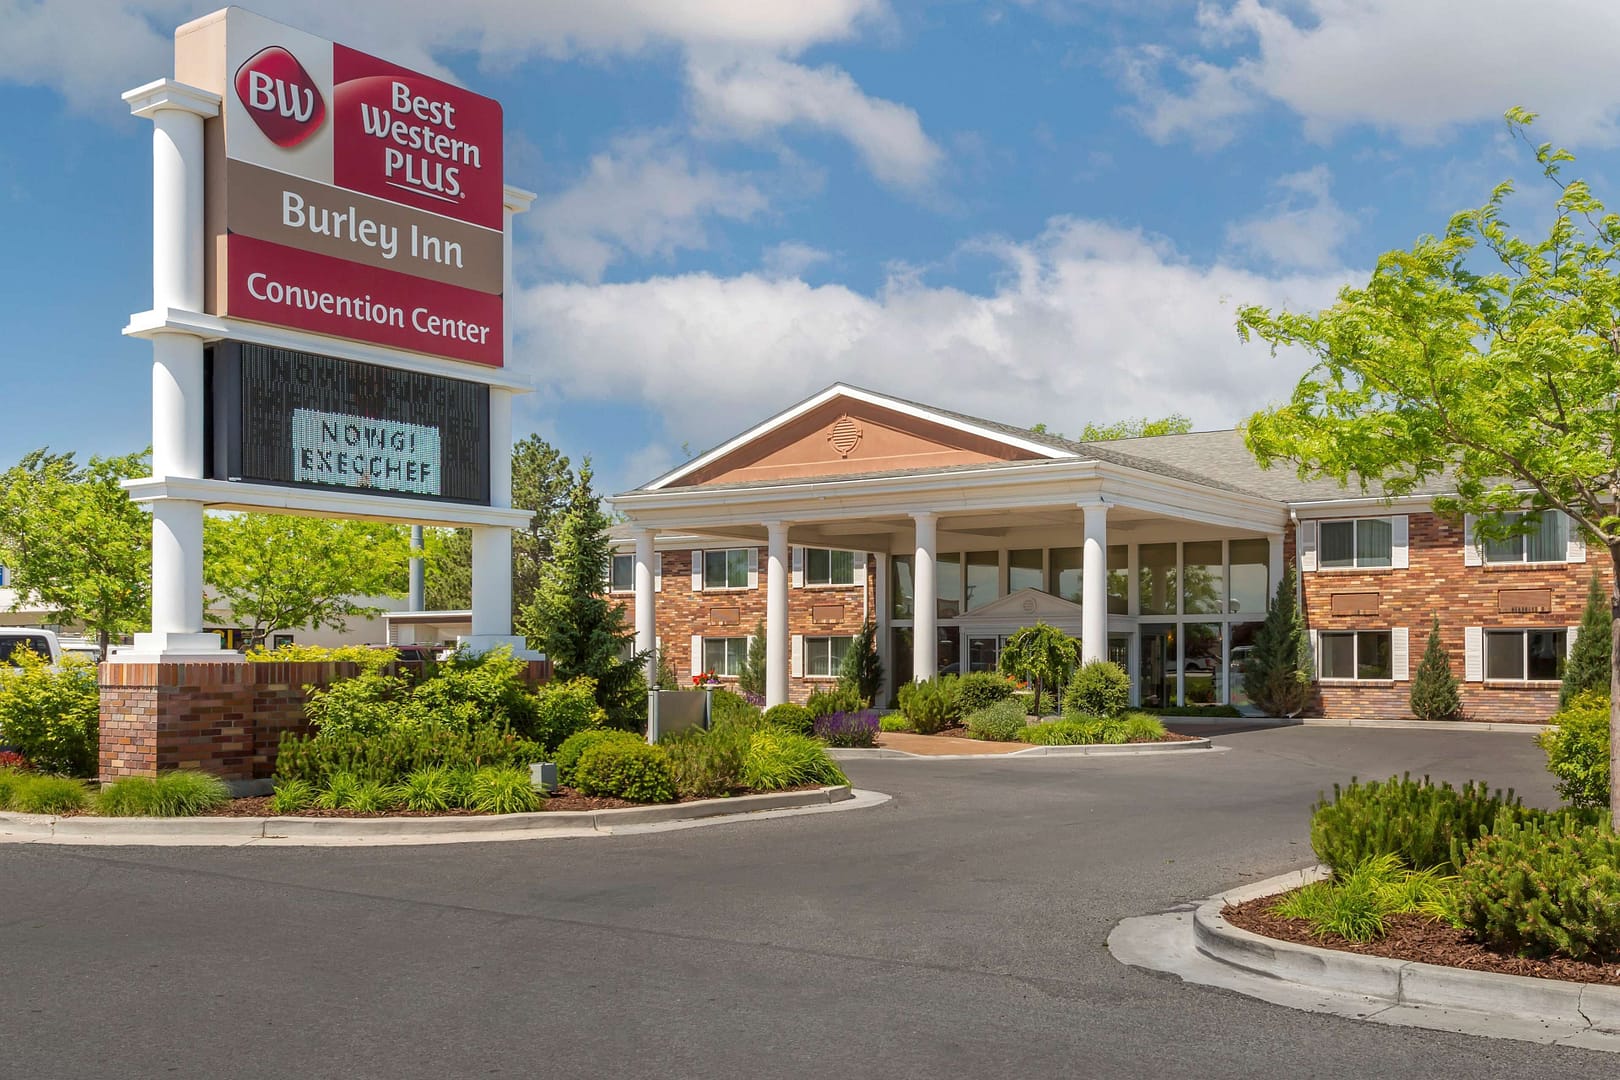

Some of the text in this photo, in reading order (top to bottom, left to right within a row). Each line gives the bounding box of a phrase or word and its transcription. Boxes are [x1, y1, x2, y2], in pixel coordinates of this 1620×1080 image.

[249, 70, 314, 123] BW
[391, 81, 456, 130] Best
[361, 102, 481, 169] Western
[282, 191, 463, 269] Burley Inn
[247, 272, 490, 345] Convention Center
